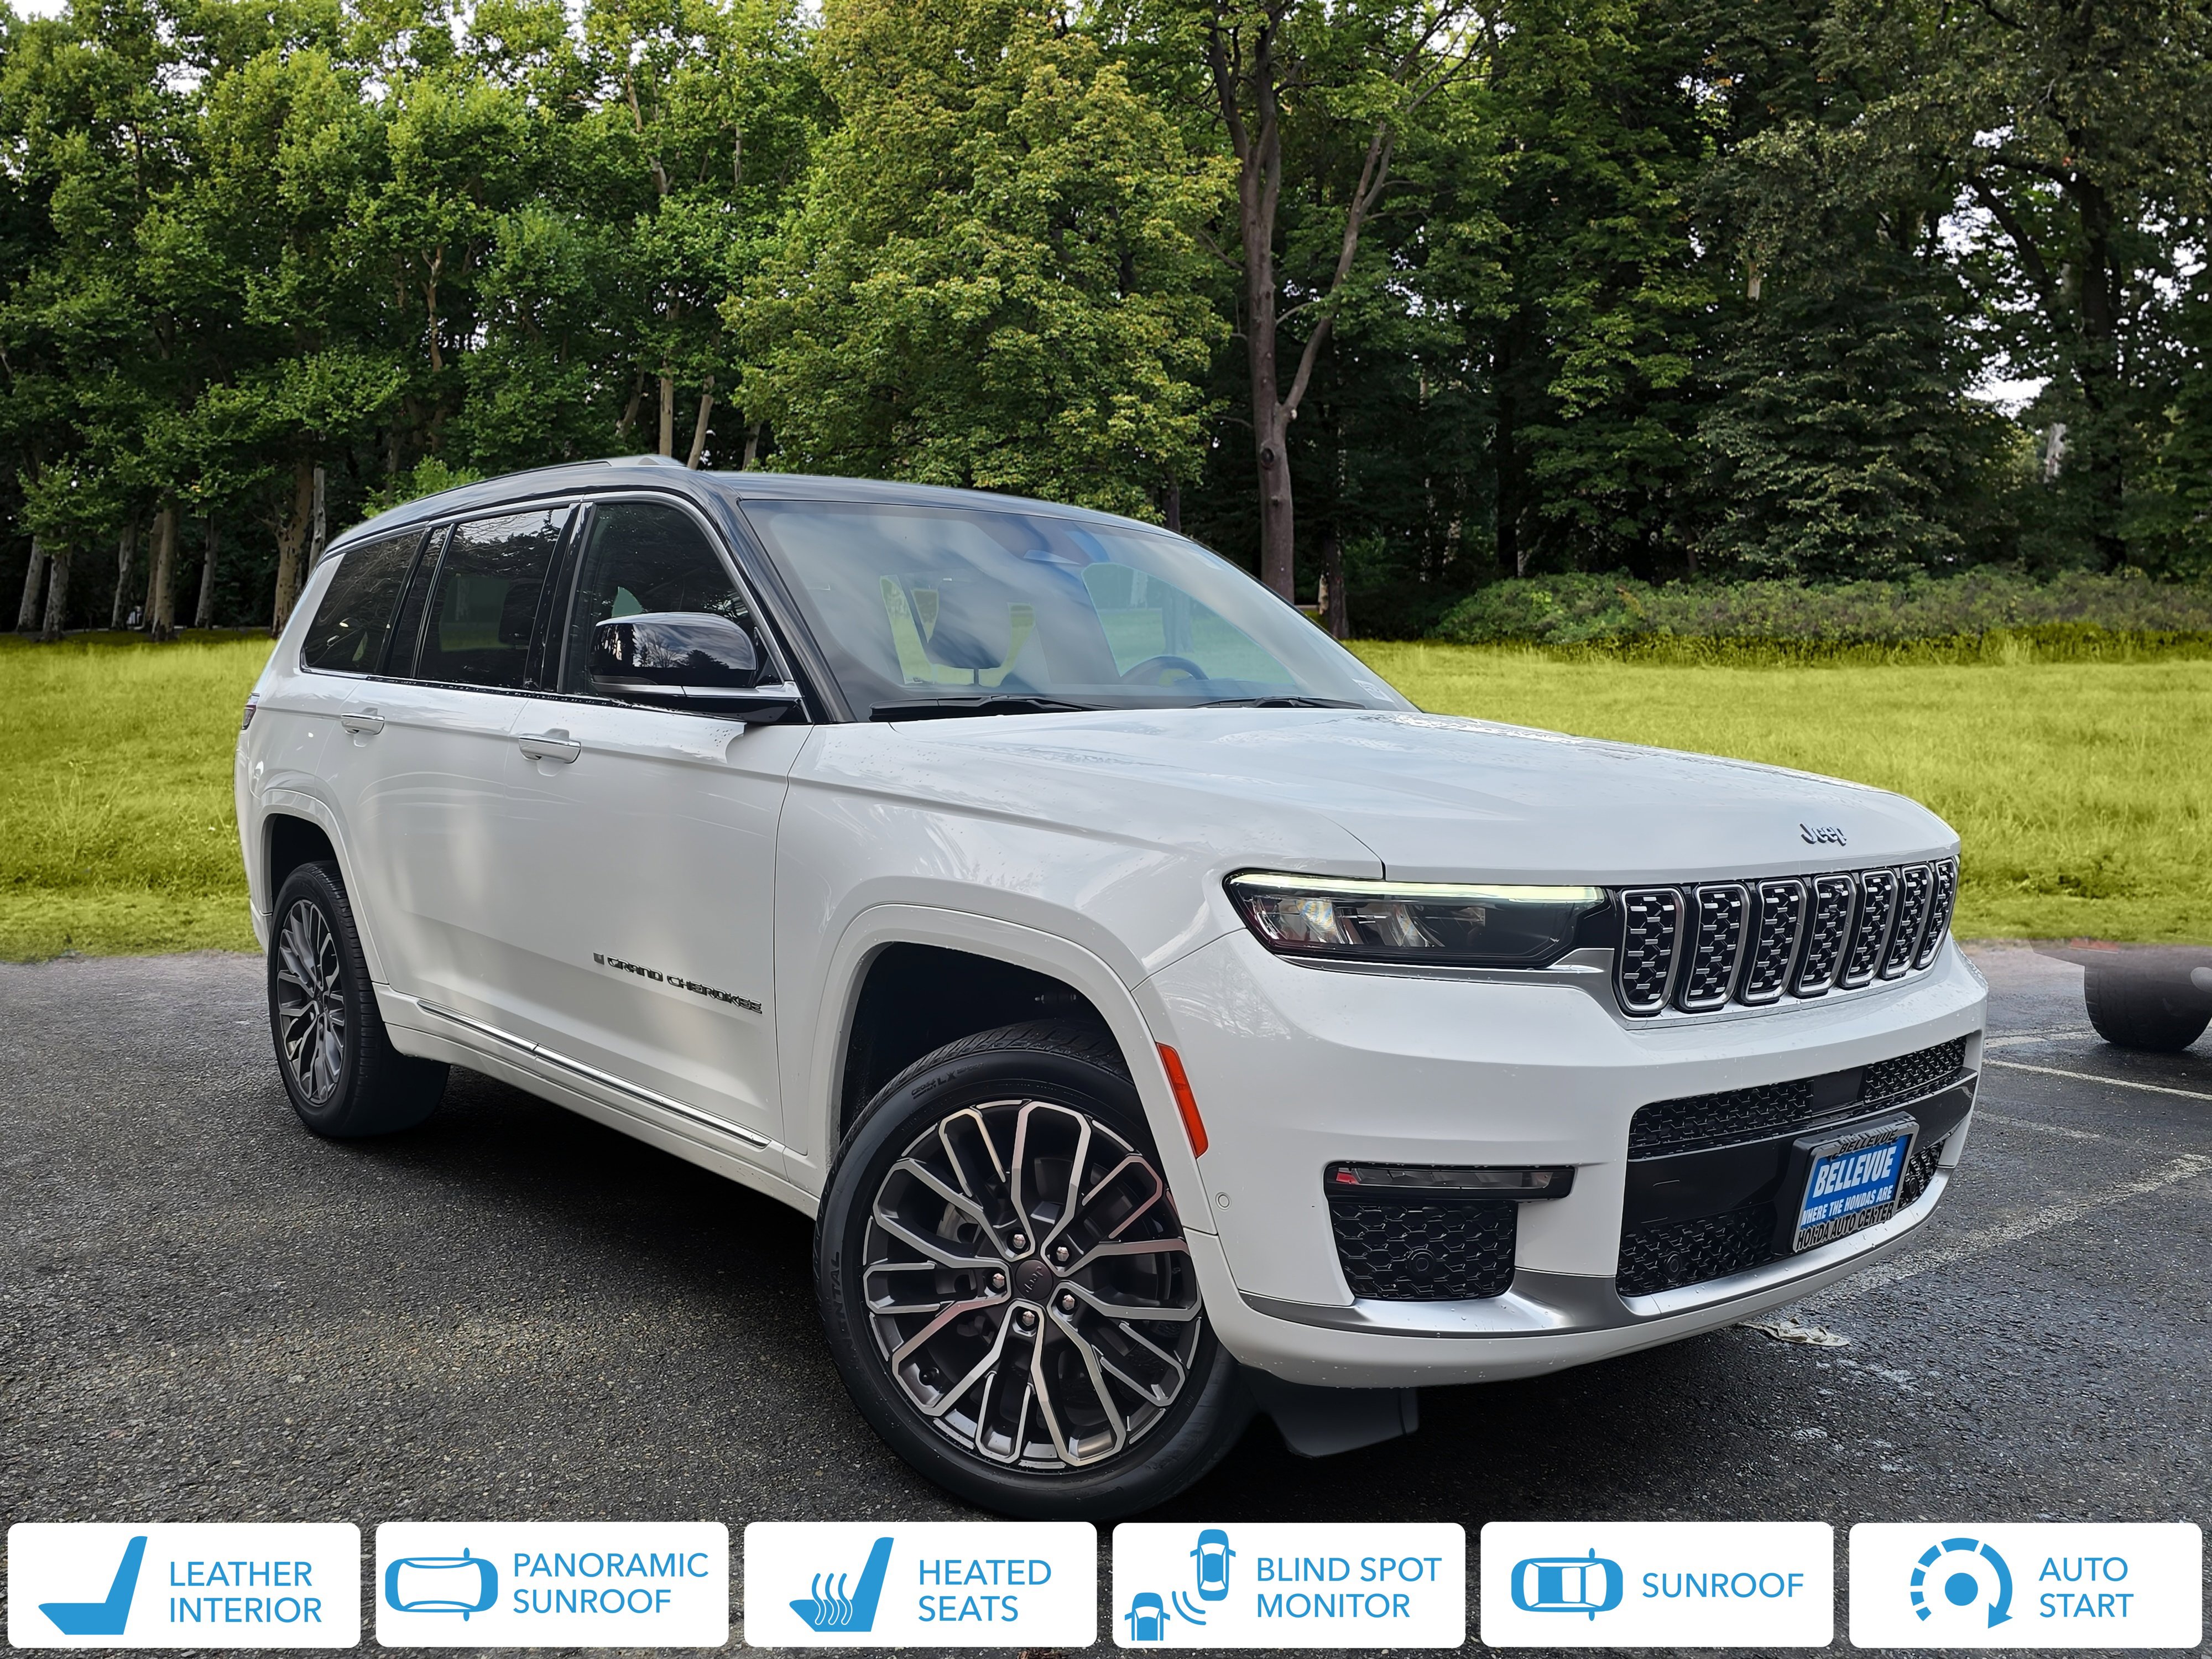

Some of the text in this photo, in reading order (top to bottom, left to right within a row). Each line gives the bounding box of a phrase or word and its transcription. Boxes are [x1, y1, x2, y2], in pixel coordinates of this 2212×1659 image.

[1799, 823, 1847, 847] Jeep
[607, 956, 763, 1014] GRAND CHEROKEE
[1839, 1129, 1897, 1154] BELLEVUE
[1813, 1146, 1897, 1198] BELLEVUE
[1798, 1202, 1895, 1250] HONDA AUTO CENTER
[1801, 1185, 1893, 1226] WHERE THE HONDAS ARE
[1023, 1265, 1044, 1293] Jeep
